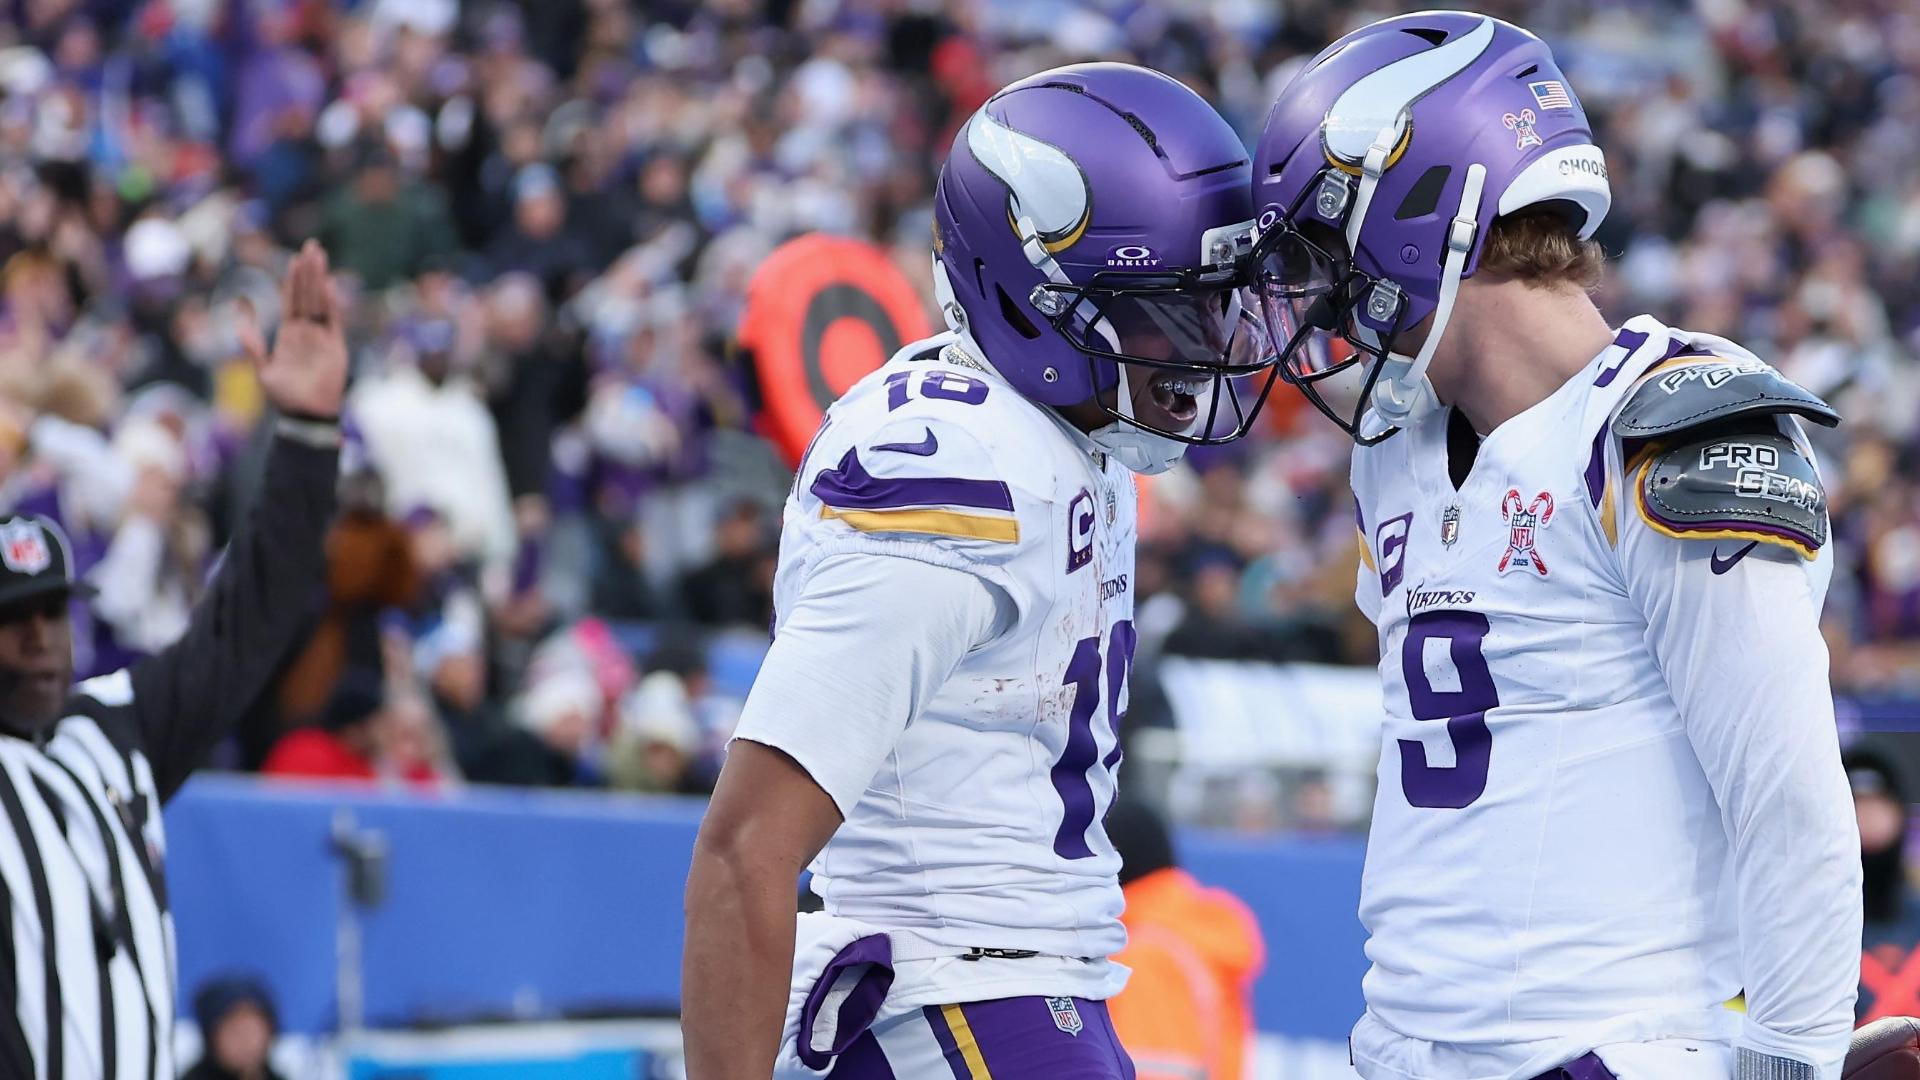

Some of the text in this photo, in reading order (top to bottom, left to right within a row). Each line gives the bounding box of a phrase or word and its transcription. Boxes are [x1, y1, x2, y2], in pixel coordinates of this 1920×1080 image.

[1107, 259, 1158, 267] OAKLEY
[883, 369, 990, 413] 18
[1699, 443, 1780, 471] PRO
[1735, 467, 1820, 516] GEAR
[1071, 496, 1095, 553] C
[1511, 527, 1533, 548] NFL
[1377, 518, 1408, 575] C
[1512, 558, 1529, 567] 2025
[1396, 609, 1500, 809] 9
[1056, 1010, 1079, 1027] NFL
